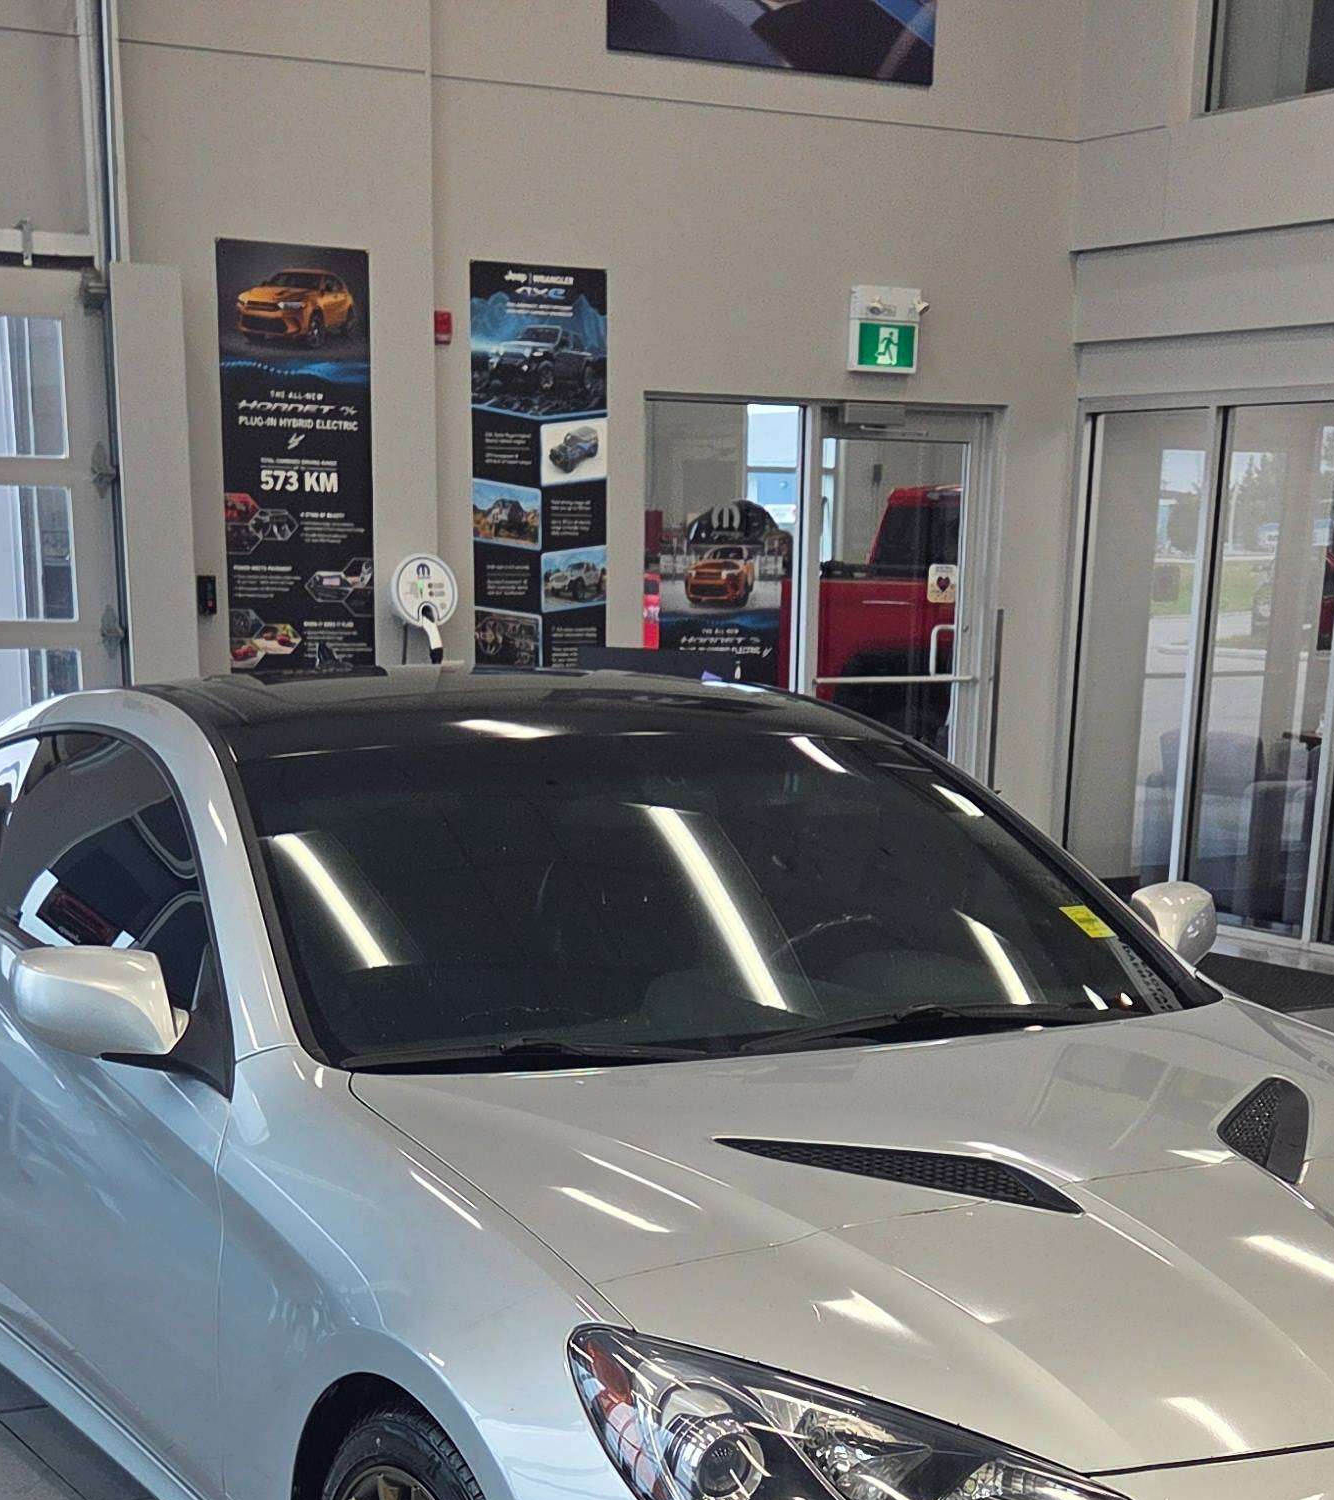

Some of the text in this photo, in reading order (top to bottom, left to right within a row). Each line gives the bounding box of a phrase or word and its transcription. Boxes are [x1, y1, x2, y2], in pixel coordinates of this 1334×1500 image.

[238, 415, 359, 432] PLUG-IN HYBRID ELECTRIC
[260, 470, 338, 492] 573 KM
